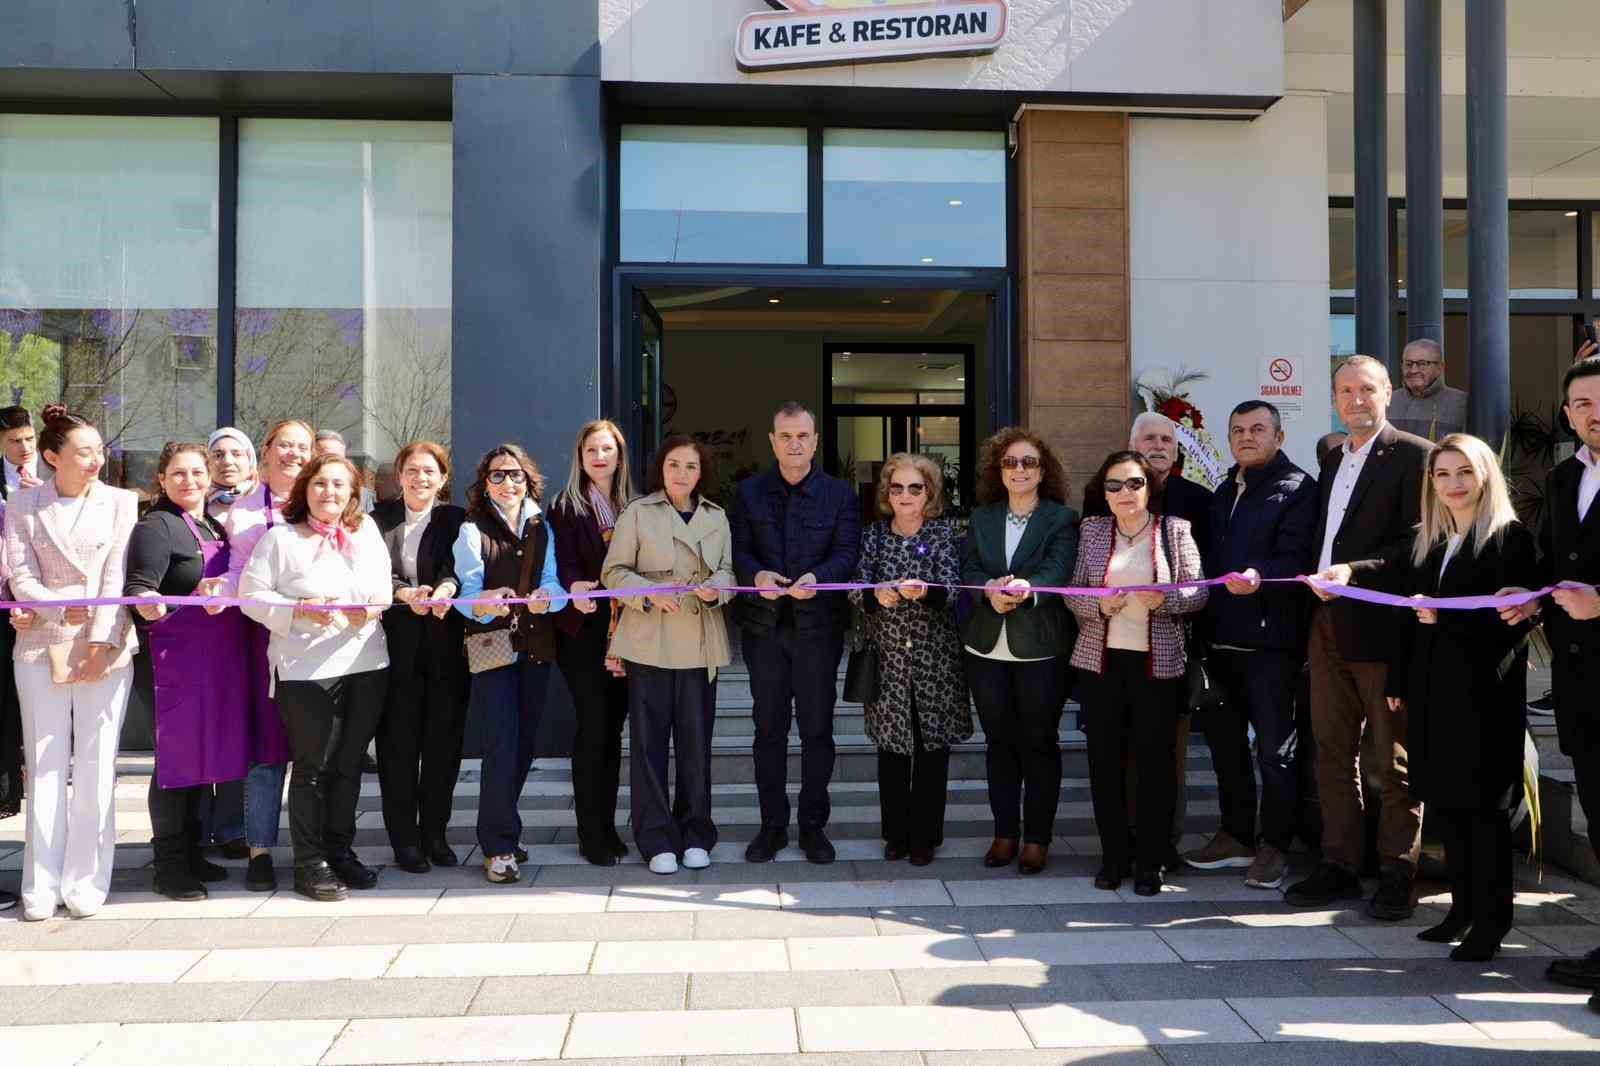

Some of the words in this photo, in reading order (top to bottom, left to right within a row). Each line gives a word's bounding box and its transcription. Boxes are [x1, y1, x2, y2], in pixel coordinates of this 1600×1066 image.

[754, 23, 821, 49] KAFE
[829, 22, 846, 43] &
[853, 12, 987, 42] RESTORAN
